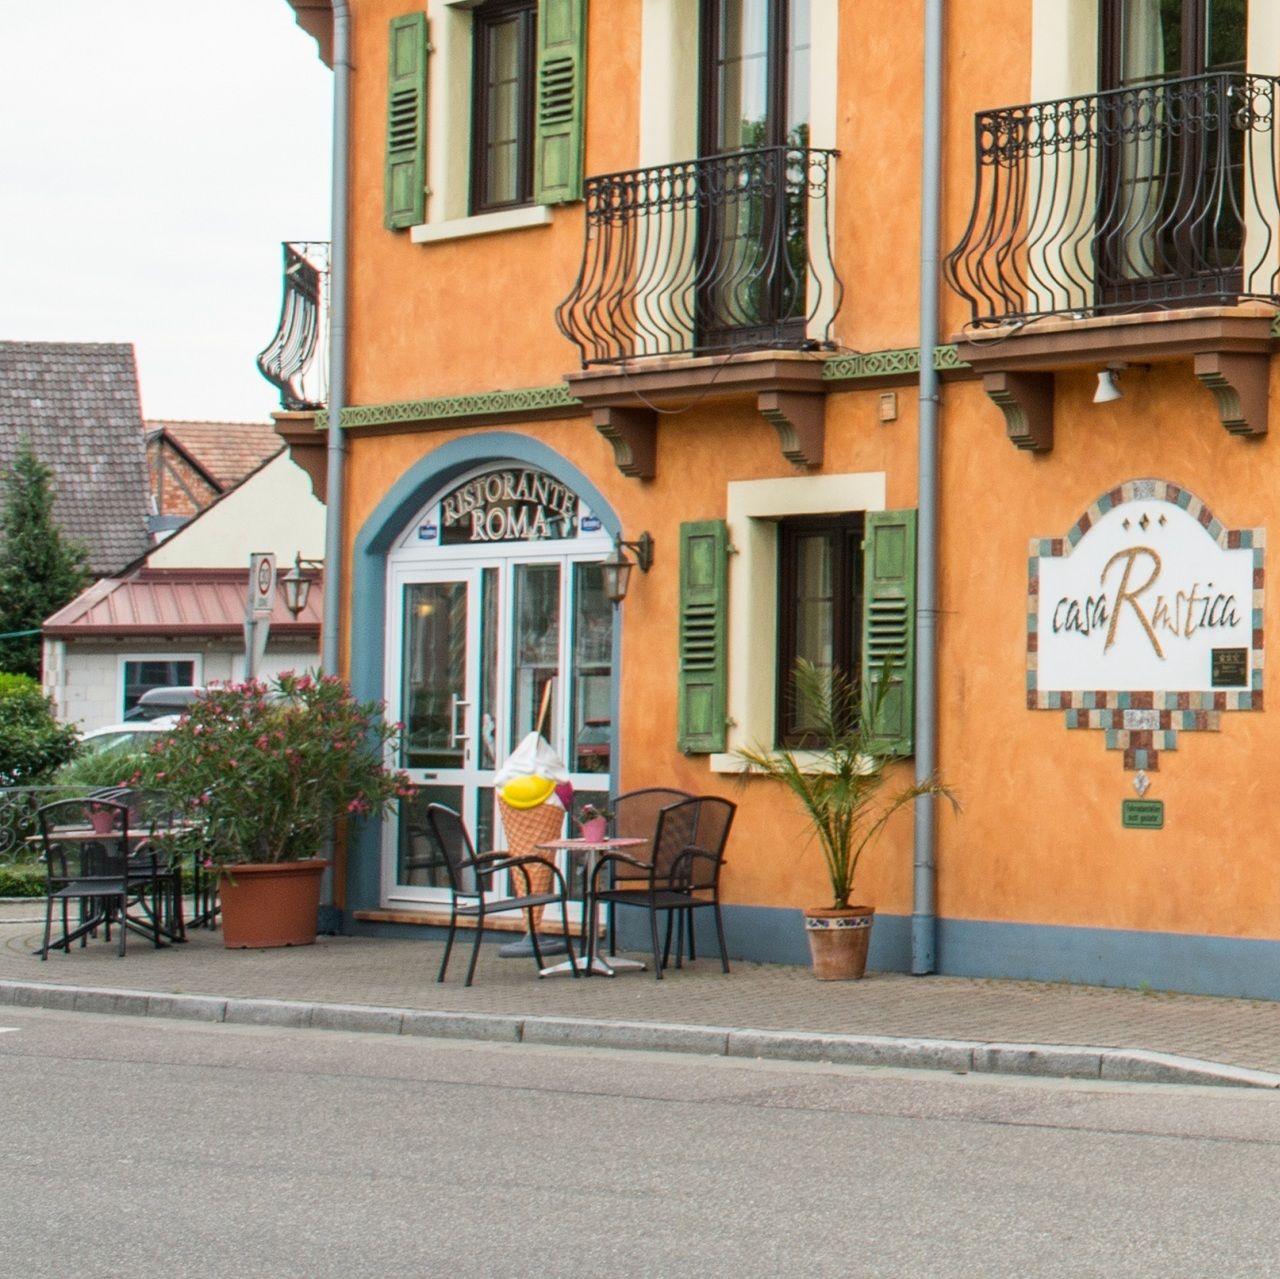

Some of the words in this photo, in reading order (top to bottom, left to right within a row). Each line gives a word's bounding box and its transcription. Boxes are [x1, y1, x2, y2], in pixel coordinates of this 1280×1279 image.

[442, 470, 577, 526] RISTORANTE
[470, 505, 552, 541] ROMA
[1052, 592, 1109, 638] casa
[1100, 545, 1242, 660] Rustica
